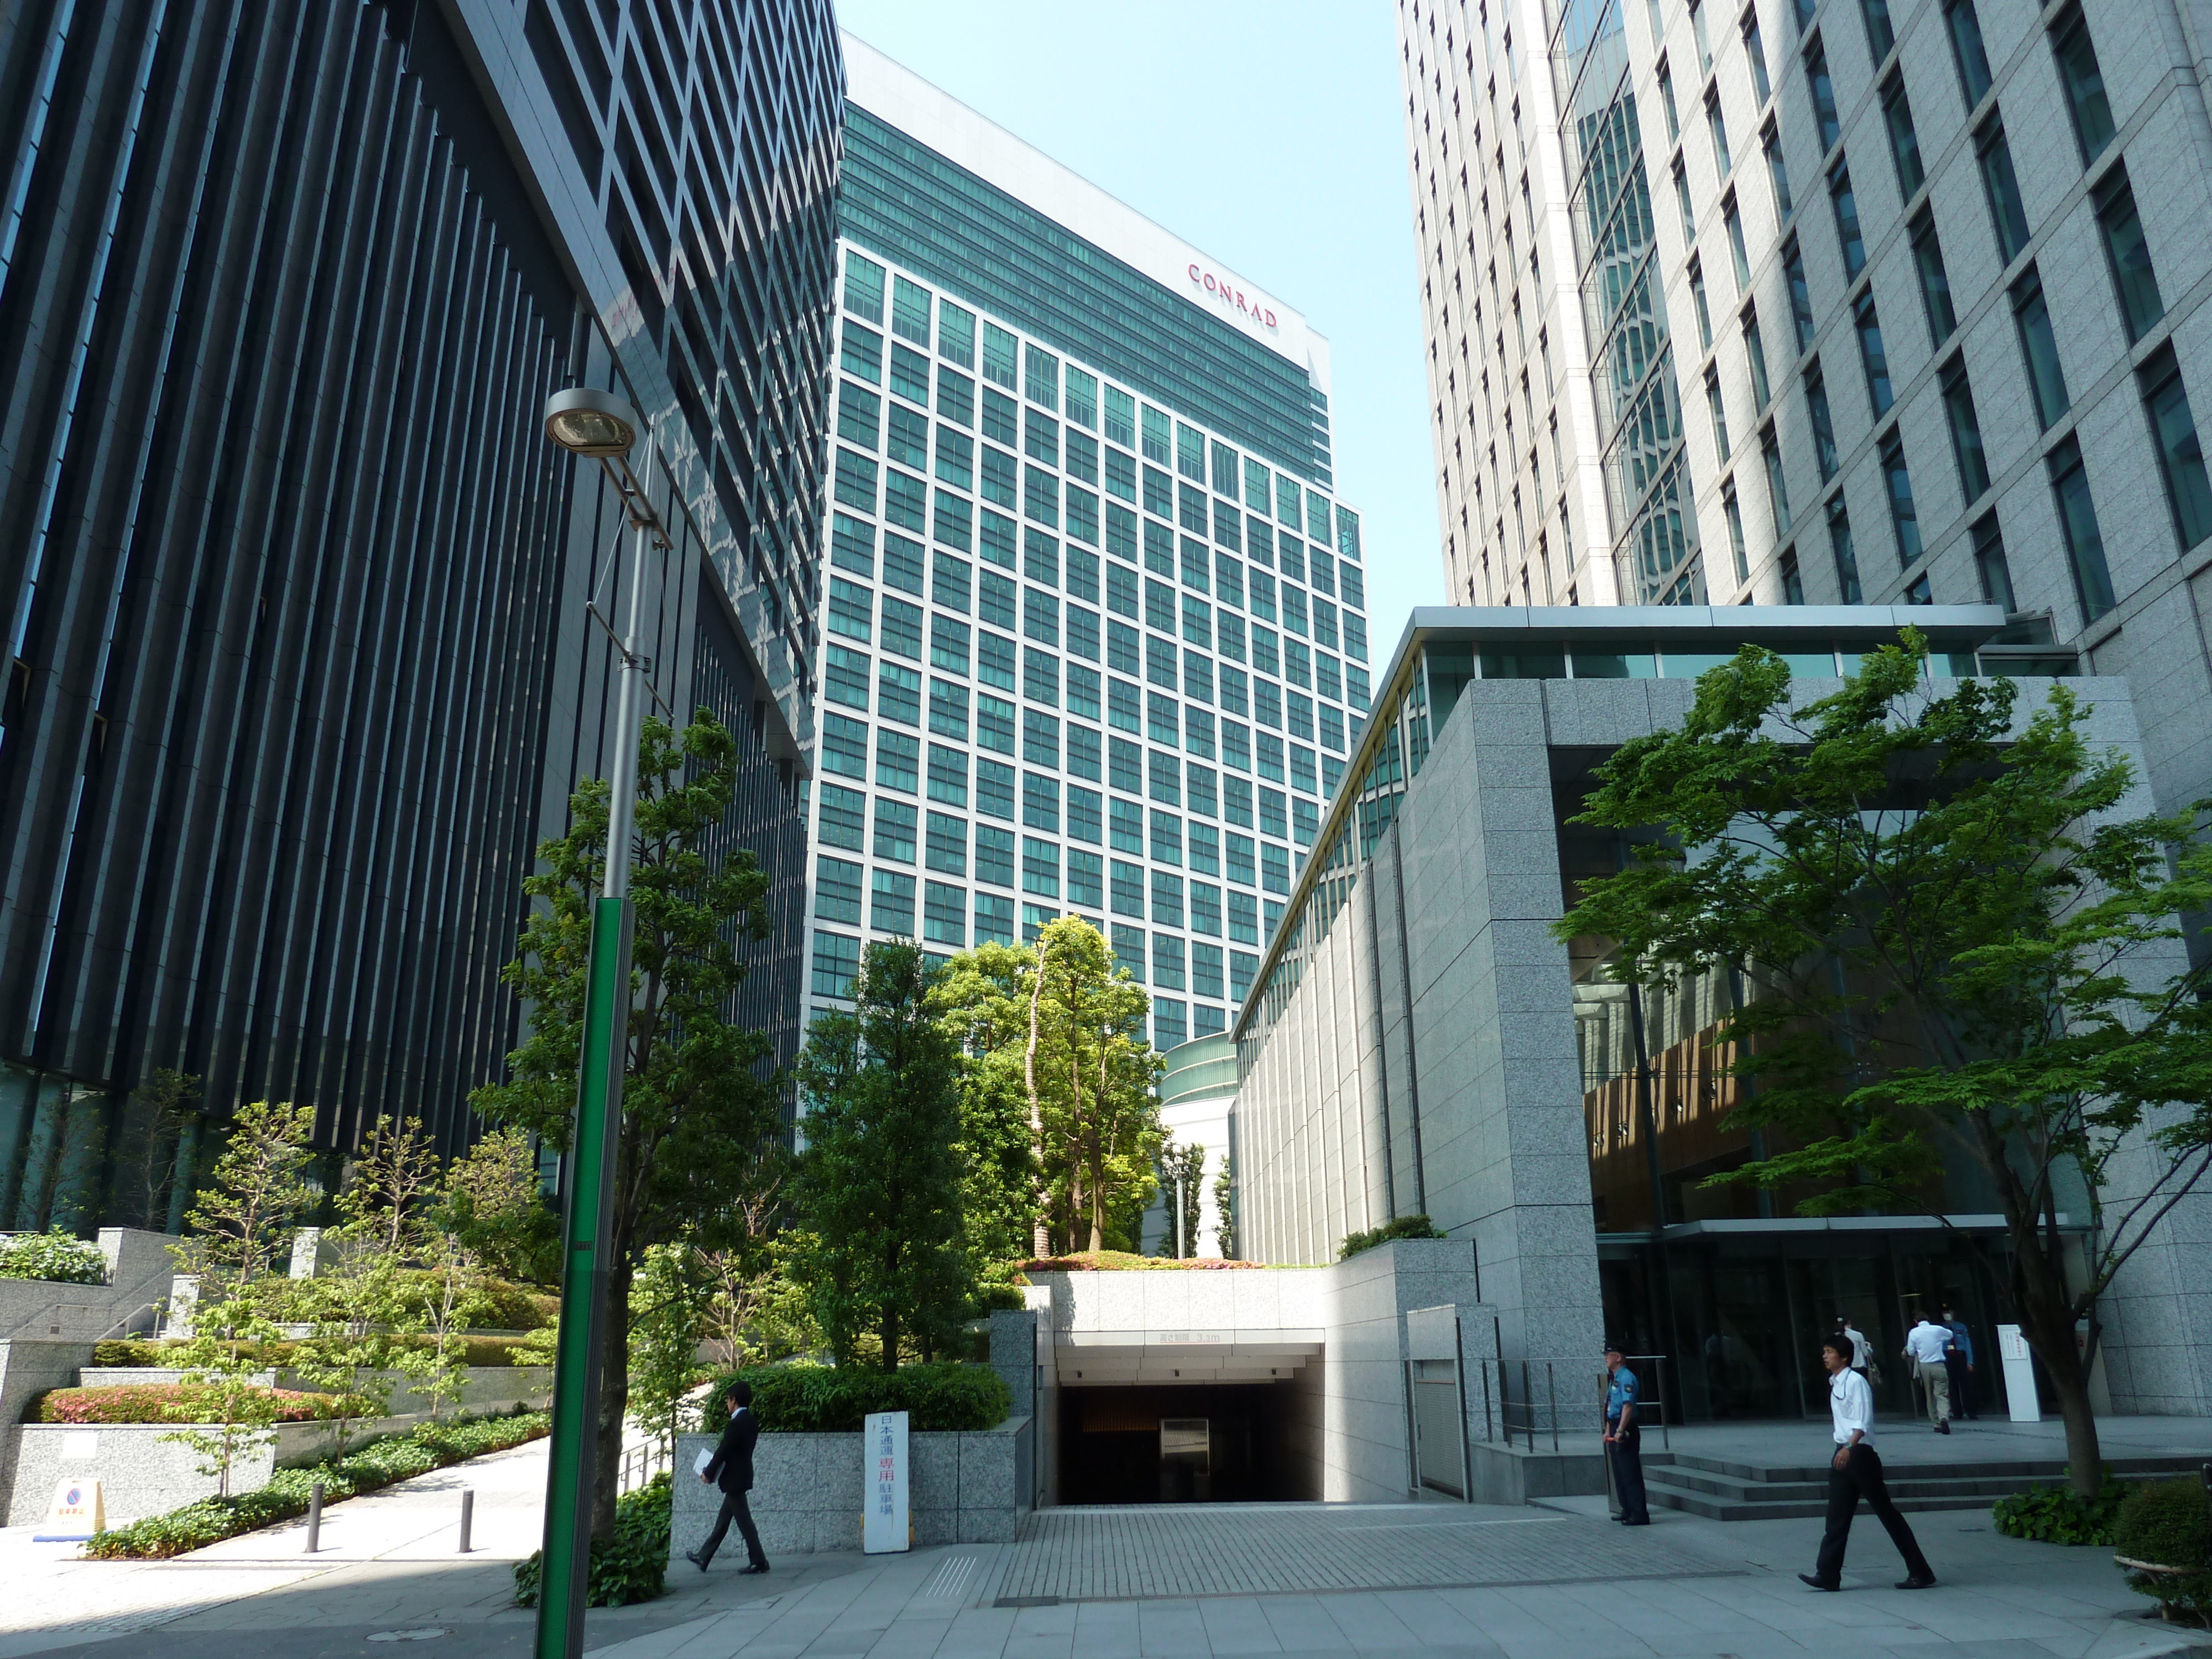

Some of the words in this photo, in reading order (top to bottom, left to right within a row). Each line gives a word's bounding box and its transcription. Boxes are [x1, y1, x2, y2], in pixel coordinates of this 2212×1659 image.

[1188, 264, 1276, 327] CONRAD
[1197, 1333, 1220, 1342] 3.3m
[879, 1415, 894, 1515] 日本通運専用駐車場
